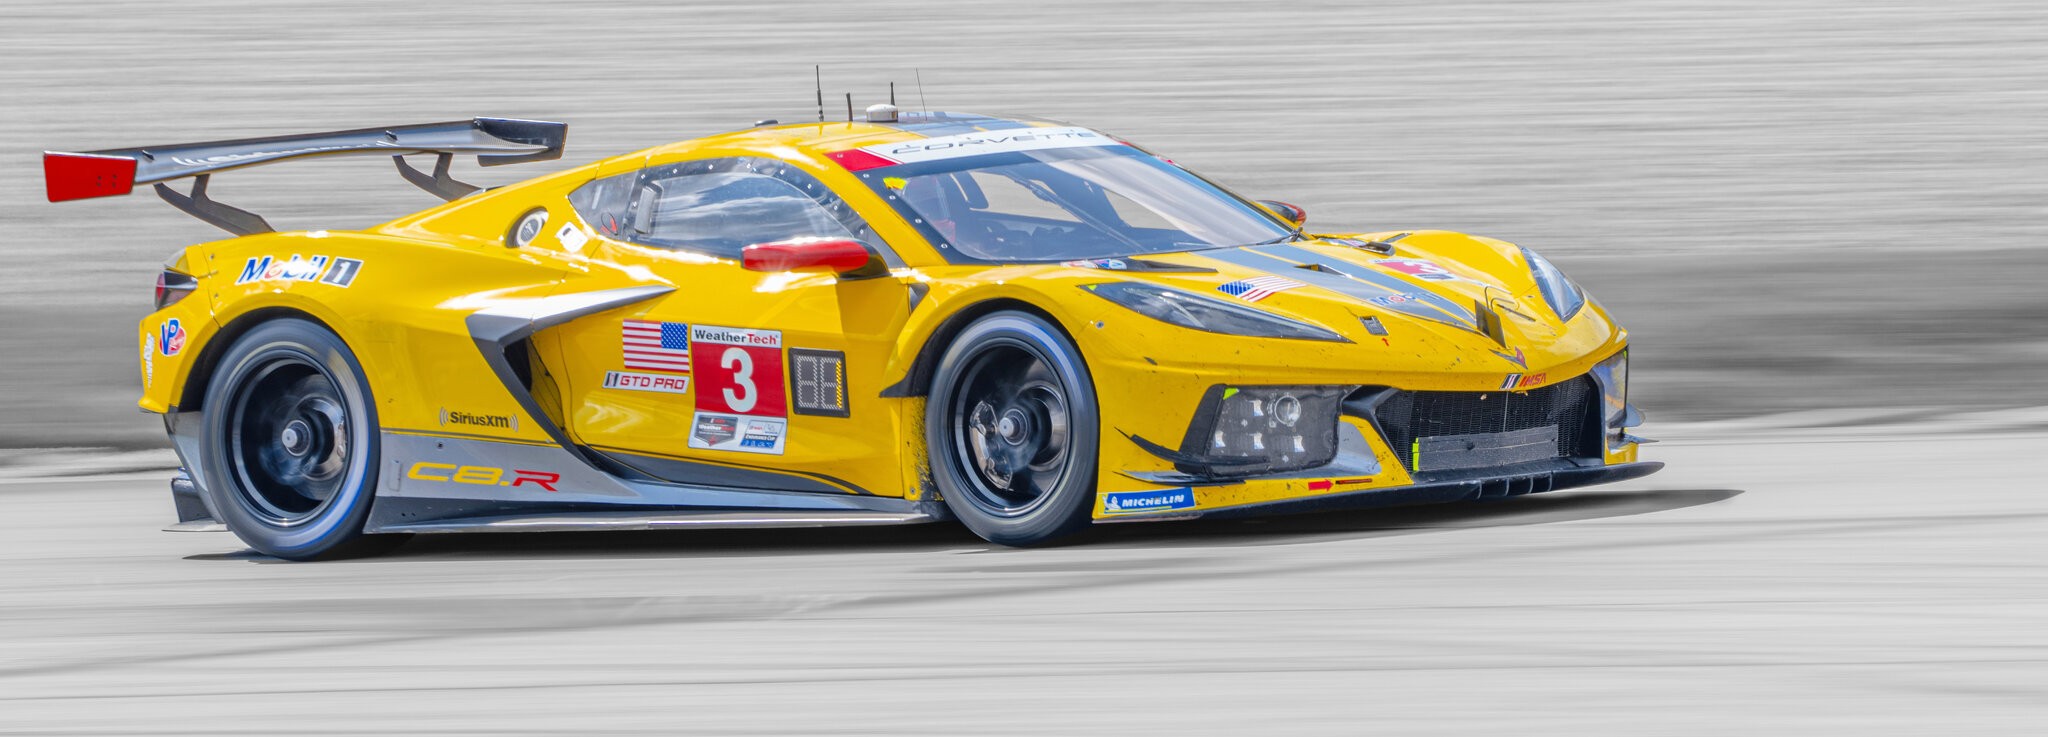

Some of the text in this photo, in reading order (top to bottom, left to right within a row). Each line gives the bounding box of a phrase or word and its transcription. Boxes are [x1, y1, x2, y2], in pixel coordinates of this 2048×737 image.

[892, 131, 1097, 154] CORVETTE
[694, 329, 776, 345] WeatherTech
[620, 375, 686, 390] GTD PRO
[720, 347, 757, 412] 3
[407, 461, 561, 492] C8.R
[1122, 494, 1184, 508] MICHELIN
